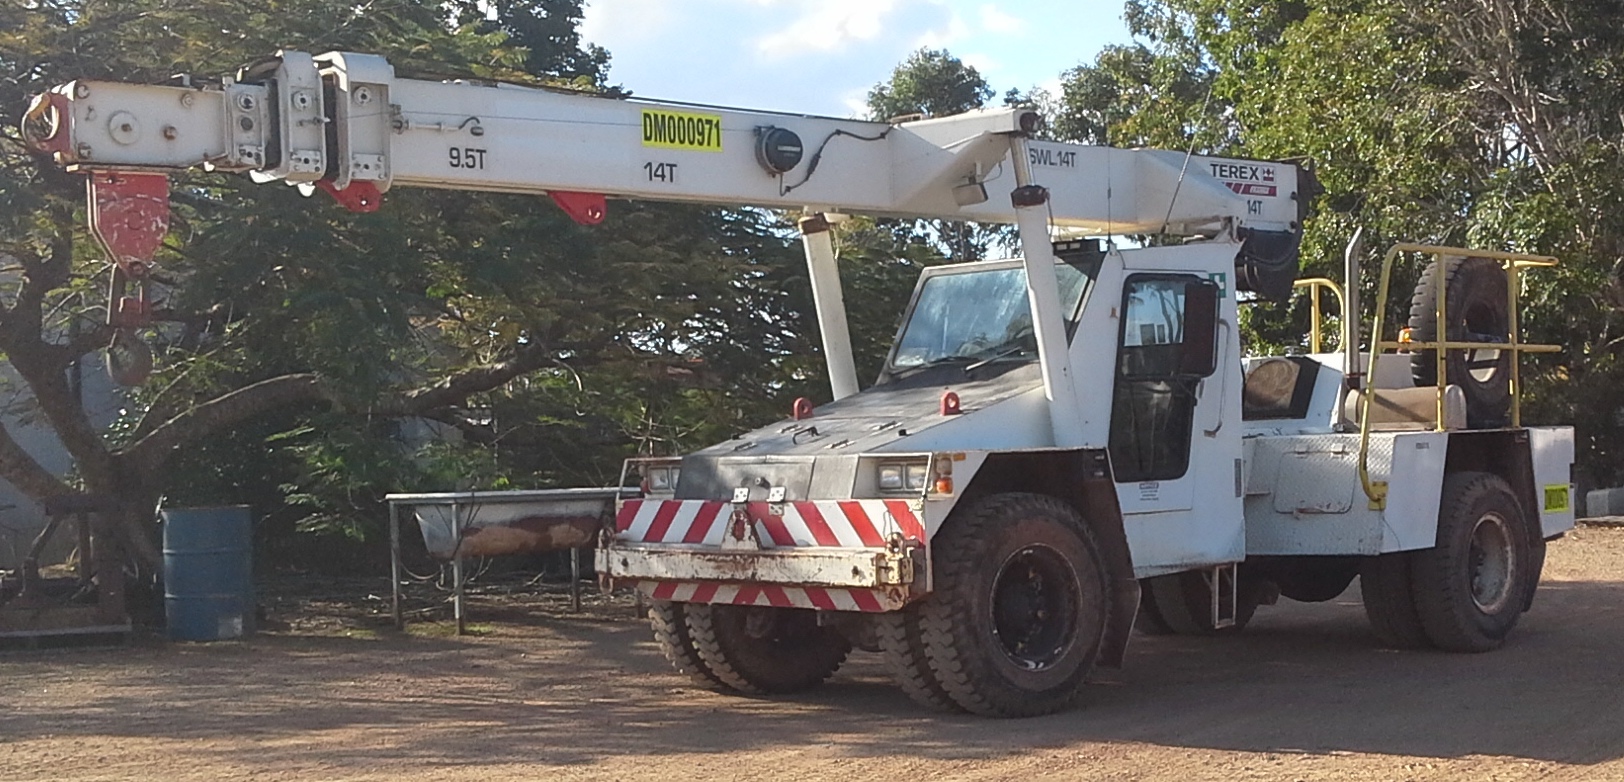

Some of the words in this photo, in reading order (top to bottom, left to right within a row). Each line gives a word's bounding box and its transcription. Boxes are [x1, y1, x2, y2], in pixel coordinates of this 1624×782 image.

[643, 112, 721, 148] DM000971
[449, 147, 487, 170] 9.5T
[643, 161, 678, 183] 14T
[1210, 163, 1260, 181] TEREX
[1247, 199, 1263, 215] 14T
